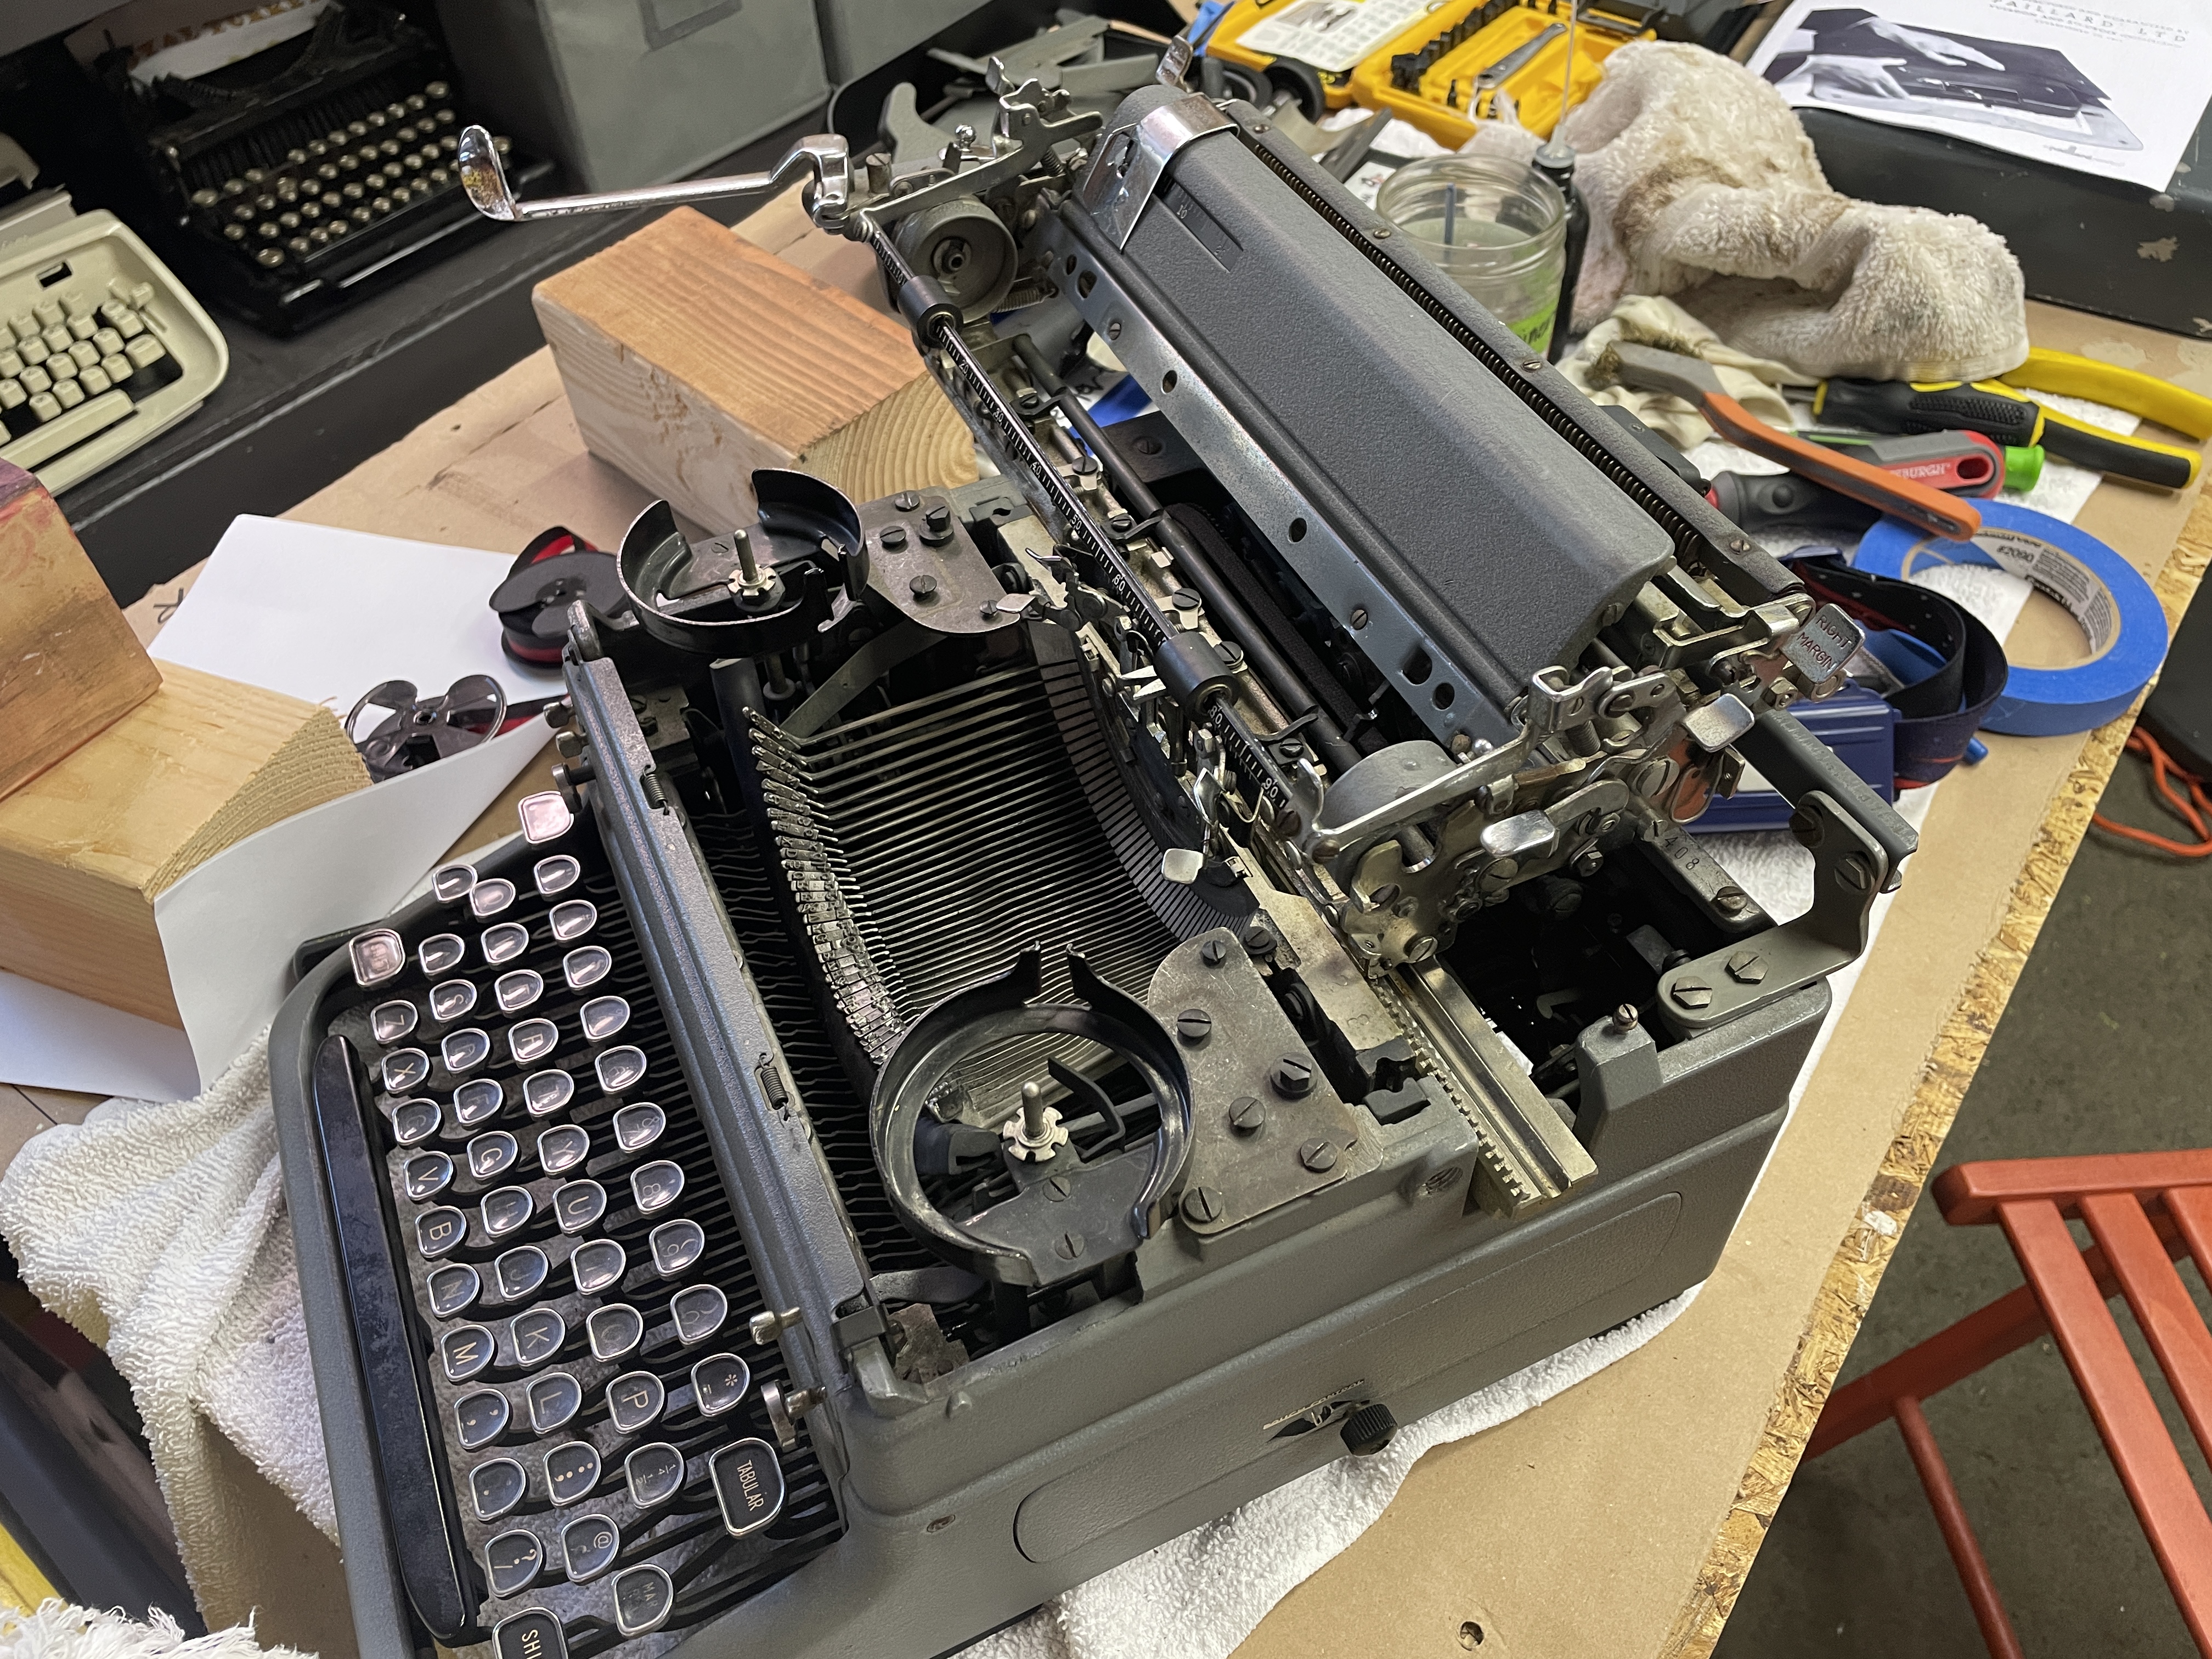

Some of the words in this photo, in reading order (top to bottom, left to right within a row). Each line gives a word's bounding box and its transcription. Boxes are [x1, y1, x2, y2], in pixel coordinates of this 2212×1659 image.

[959, 361, 969, 374] 20
[994, 408, 1003, 422] 30
[1031, 461, 1042, 476] 40
[1070, 514, 1082, 530] 50
[1113, 574, 1126, 592] 60
[1816, 615, 1852, 650] RIGHT
[1796, 632, 1837, 673] MARGIN
[1209, 705, 1223, 725] 80
[1263, 777, 1279, 798] 90
[1664, 837, 1700, 870] 408
[383, 1014, 405, 1030] Z
[394, 1062, 416, 1077] X
[481, 1147, 503, 1164] G
[552, 1141, 576, 1155] Y
[418, 1166, 439, 1181] V
[642, 1183, 661, 1197] 8
[568, 1195, 592, 1215] U
[429, 1221, 452, 1241] B
[662, 1244, 679, 1257] 9
[441, 1279, 465, 1301] N
[524, 1327, 550, 1349] K
[453, 1342, 479, 1366] M
[540, 1391, 563, 1414] L
[621, 1390, 648, 1408] P
[737, 1459, 765, 1511] TABULAR
[593, 1531, 613, 1549] @
